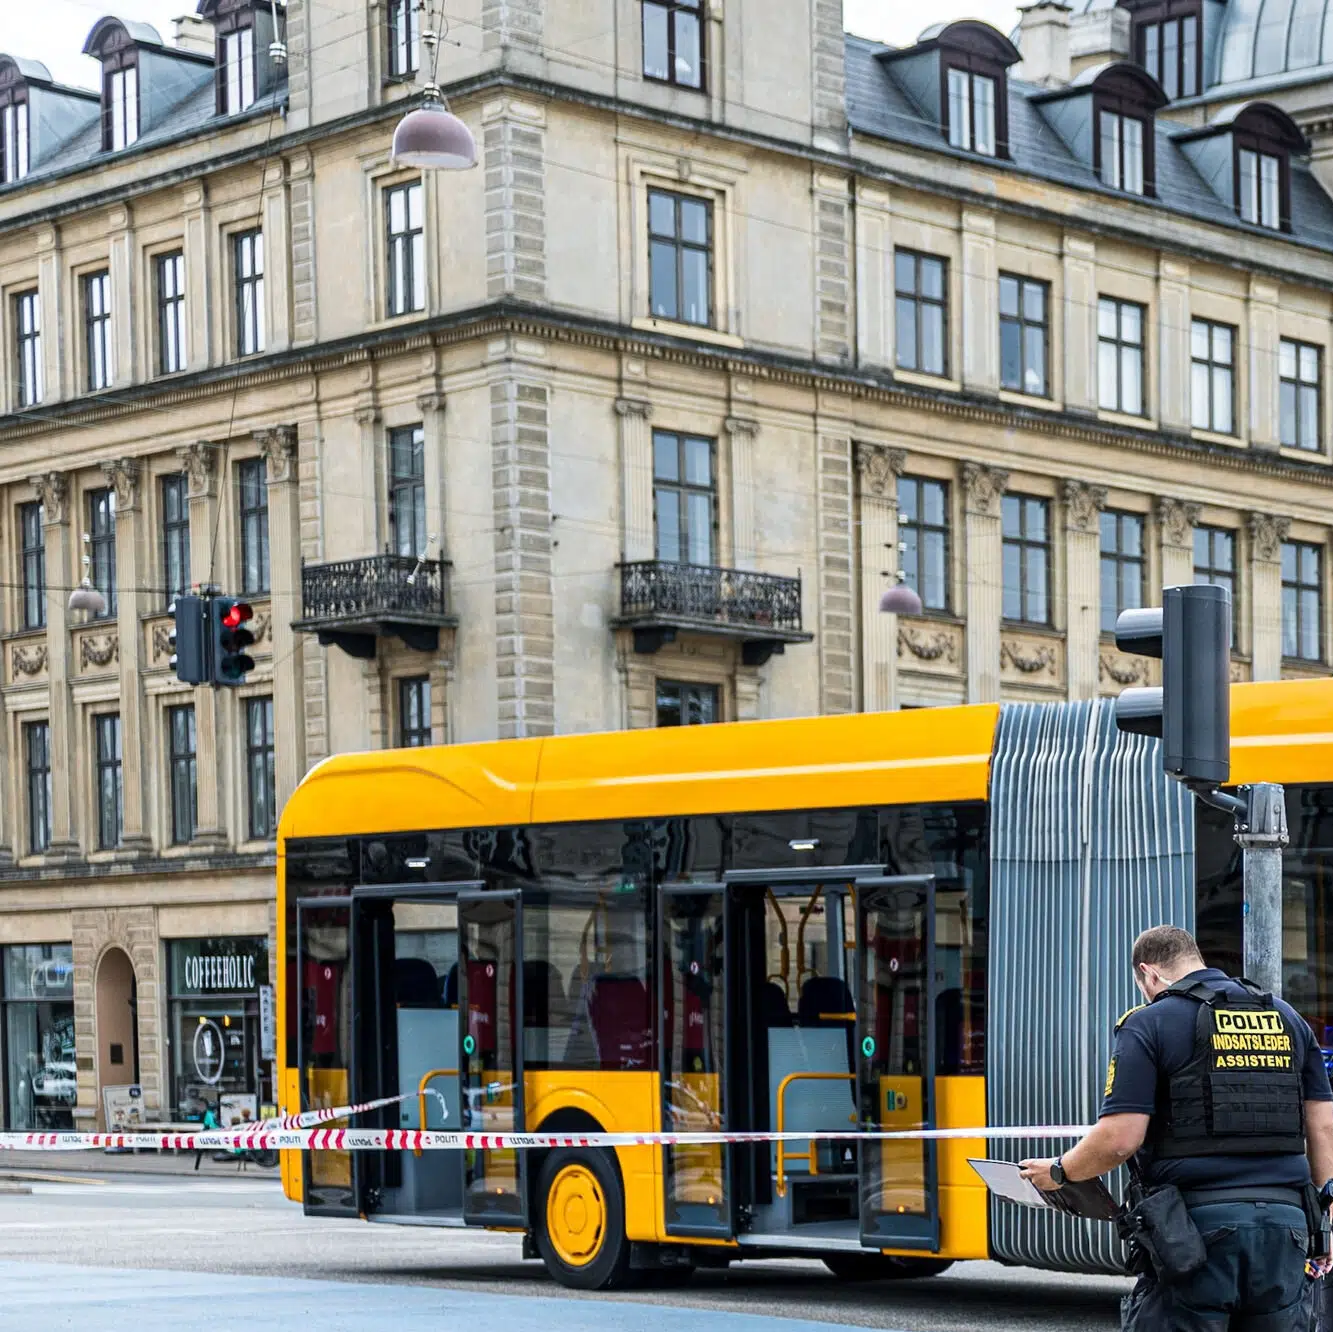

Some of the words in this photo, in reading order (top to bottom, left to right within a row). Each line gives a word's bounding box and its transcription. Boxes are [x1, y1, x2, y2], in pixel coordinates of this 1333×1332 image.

[185, 955, 255, 989] COFFEEHOLIC
[1218, 1014, 1282, 1030] POLITI
[1212, 1034, 1291, 1051] INDSATSLEDER
[1216, 1055, 1291, 1068] ASSISTENT
[279, 1135, 301, 1144] POLITI
[435, 1135, 459, 1144] POLITI
